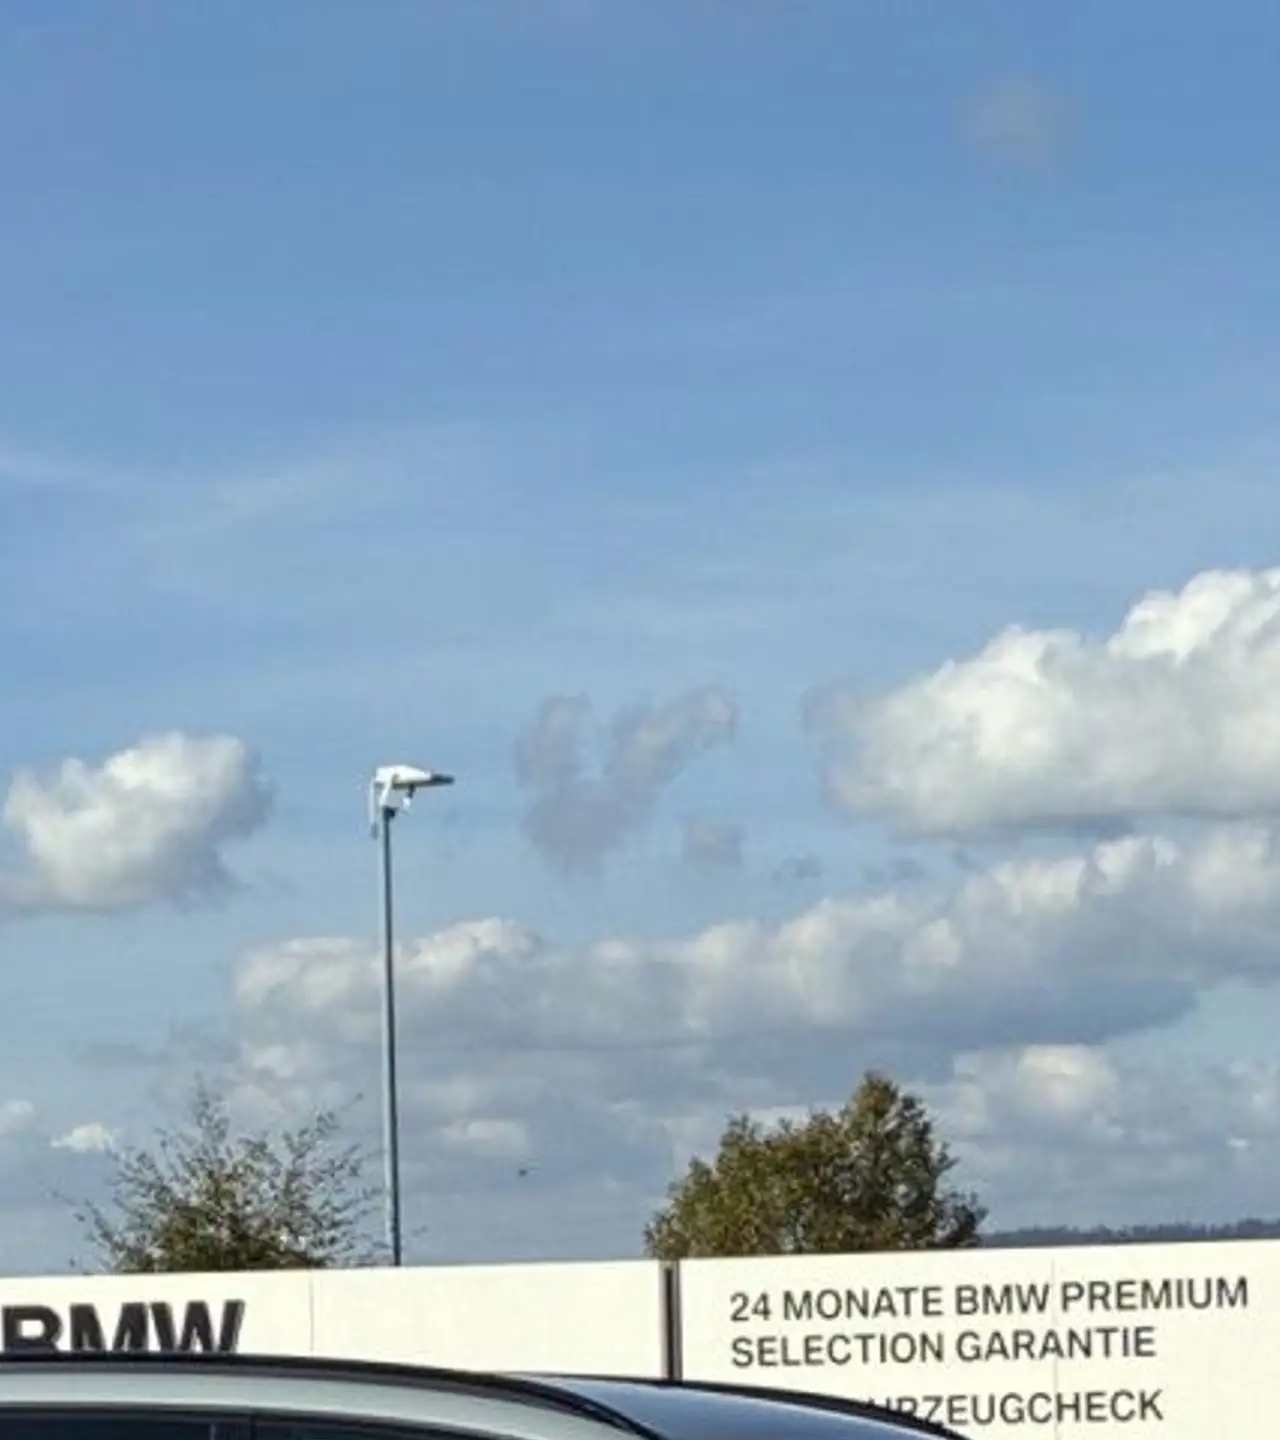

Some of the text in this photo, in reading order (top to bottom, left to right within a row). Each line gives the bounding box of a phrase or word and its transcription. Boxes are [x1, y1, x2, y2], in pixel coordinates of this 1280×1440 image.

[730, 1276, 1248, 1322] 24 MONATE BMW PREMIUM
[2, 1300, 246, 1353] BMW
[731, 1326, 1155, 1368] SELECTION GARANTIE
